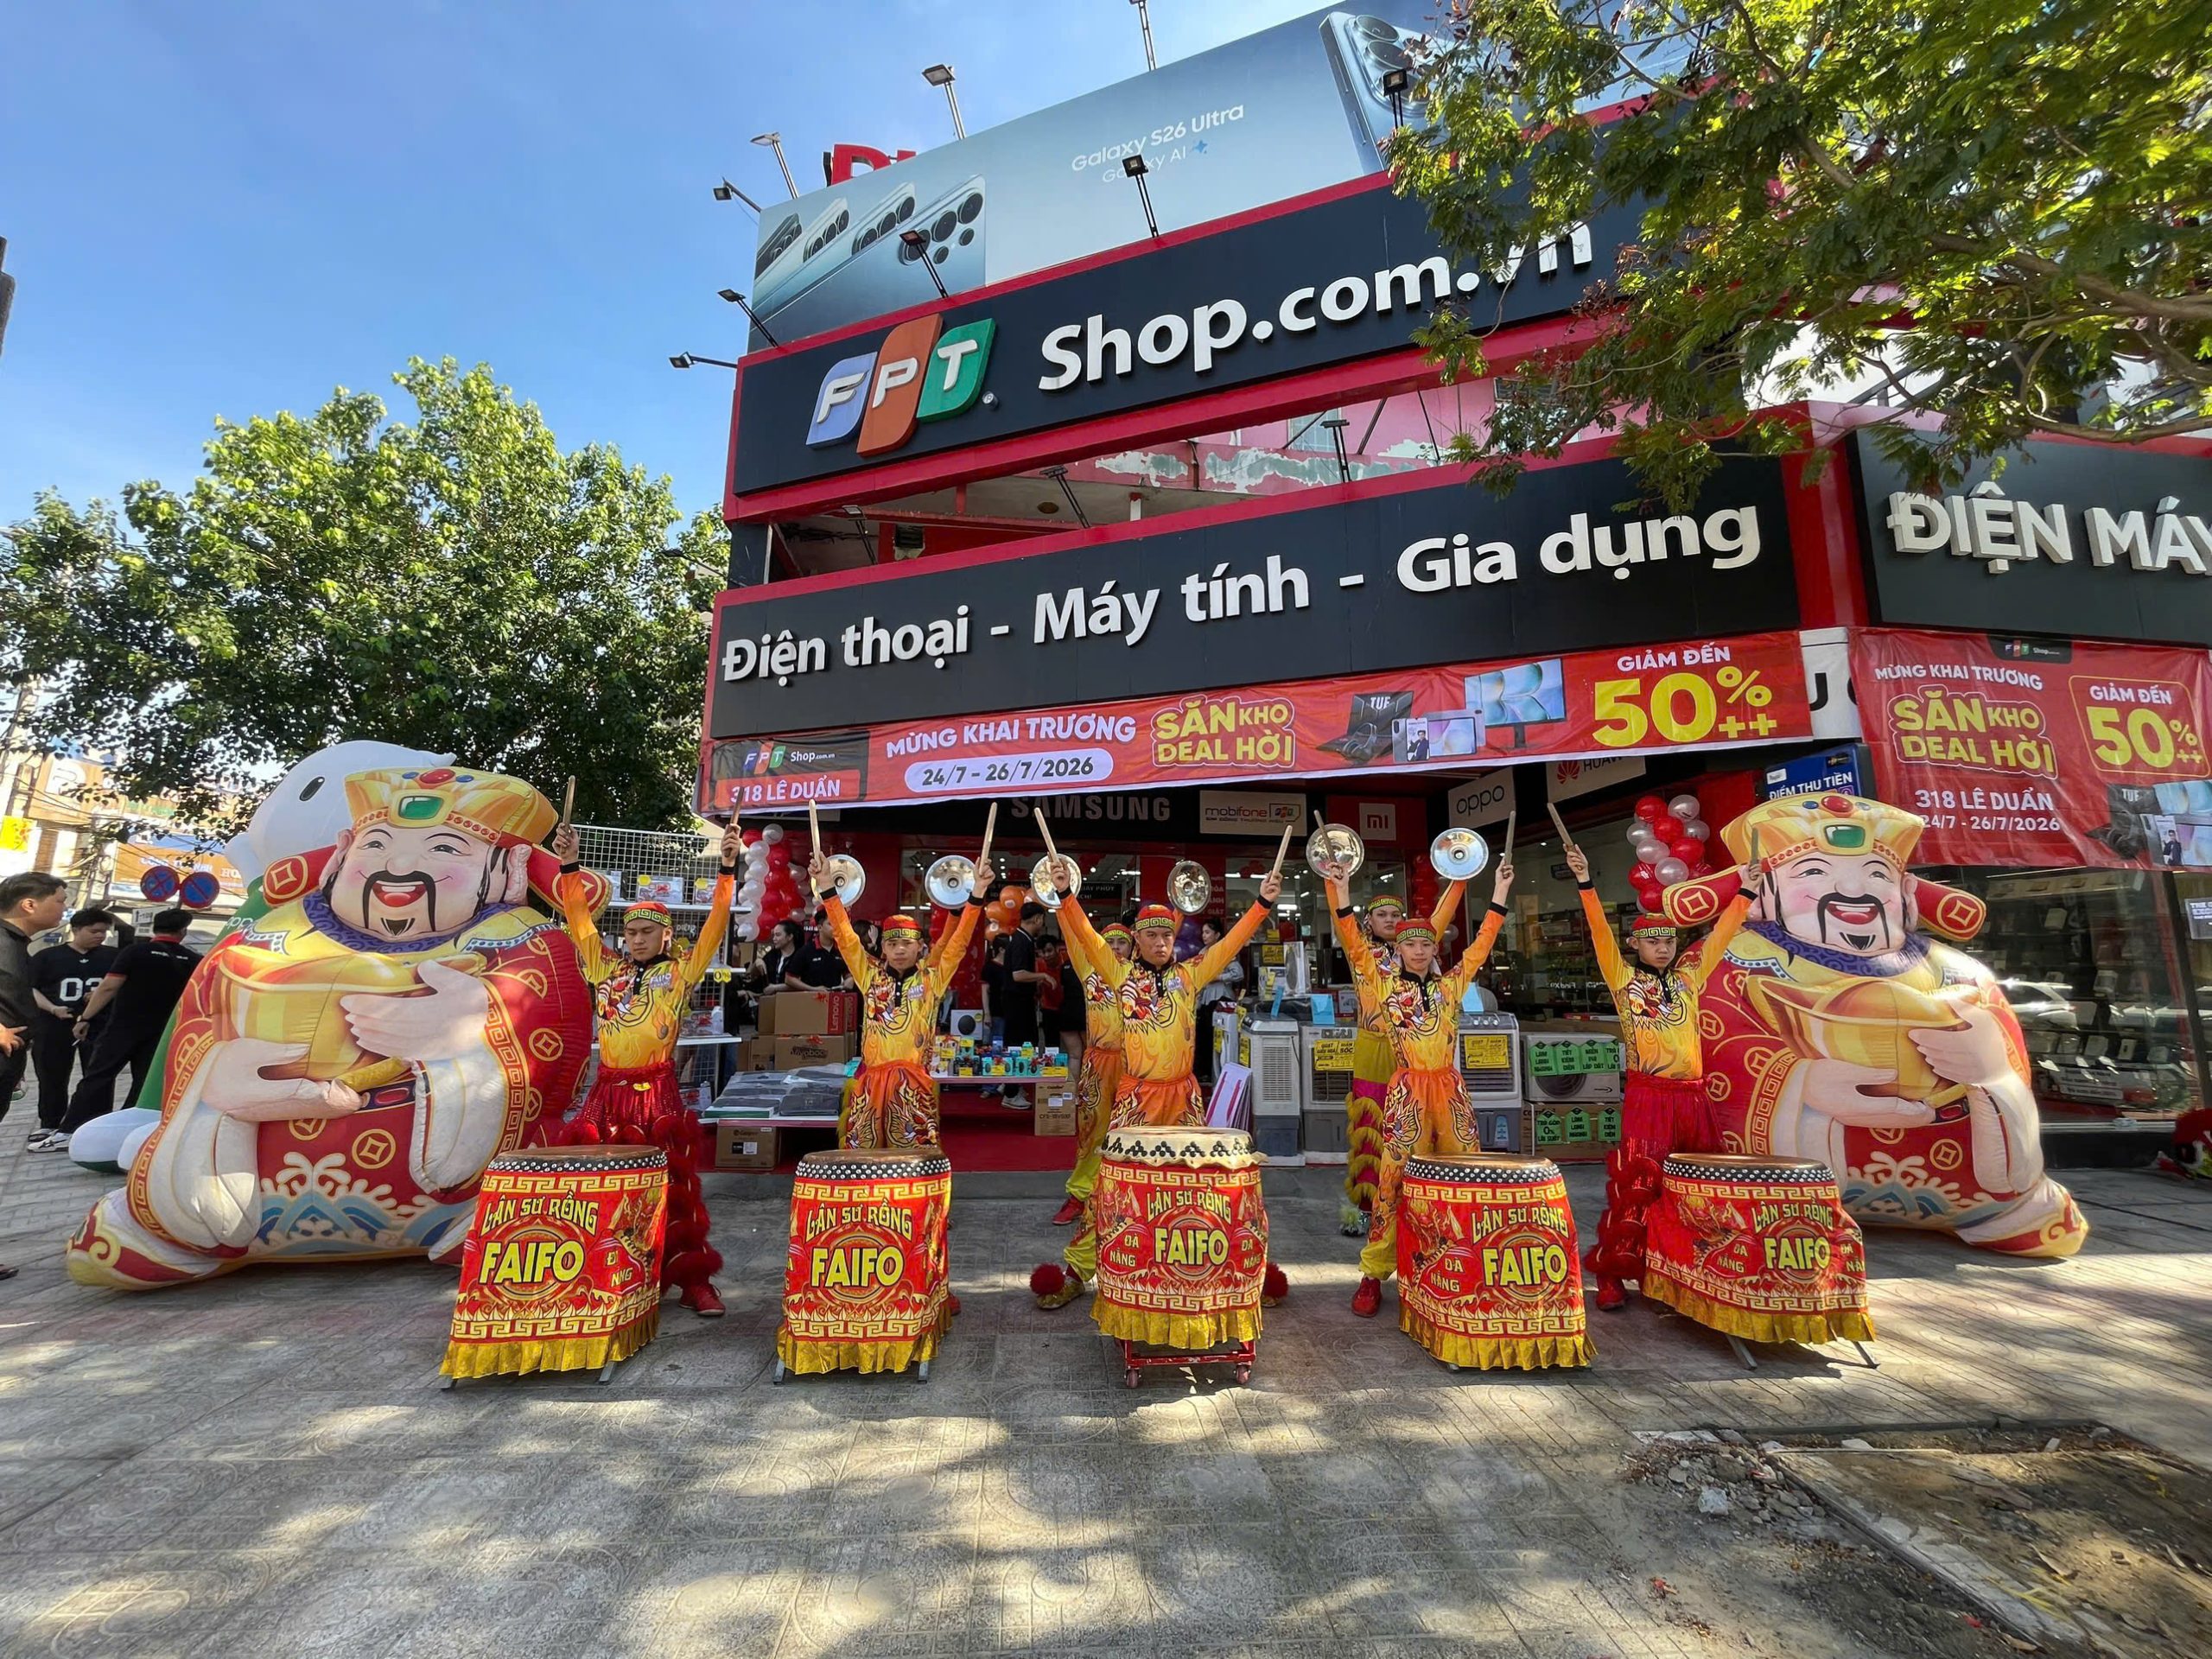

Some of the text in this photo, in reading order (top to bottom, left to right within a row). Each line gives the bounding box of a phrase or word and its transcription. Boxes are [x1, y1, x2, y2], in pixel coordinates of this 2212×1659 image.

[1071, 104, 1244, 172] Galaxy S26 Ultra
[1103, 145, 1186, 183] Gaxy AI
[814, 220, 1593, 427] FPT Shop.com.vn
[1886, 480, 2073, 575] ĐIỆN
[721, 628, 826, 688] Điện
[841, 603, 969, 671] thoại
[1033, 580, 1161, 647] Máy
[1180, 554, 1311, 623] tính
[1395, 531, 1518, 594] Gia
[1539, 504, 1762, 582] dụng
[1616, 640, 1732, 675] GIẢM ĐẾN
[1874, 662, 2044, 692] MỪNG KHAI TRƯƠNG
[2089, 682, 2173, 705] GIẢM ĐẾN
[1156, 699, 1288, 740] SĂN KHO
[1893, 690, 1987, 734] SĂN
[1987, 705, 2040, 730] KHO
[886, 713, 1136, 758] MỪNG KHAI TRƯƠNG
[1157, 728, 1293, 763] DEAL HỜI
[1901, 734, 2056, 774] DEAL HỜI
[766, 779, 787, 801] LÊ
[921, 765, 968, 787] 24/7
[984, 757, 1095, 782] 26/7/2026
[1798, 779, 1822, 793] THU
[1823, 771, 1853, 787] TIỀN
[1010, 794, 1171, 822] SAMSUNG
[1205, 806, 1268, 817] mobifone
[1915, 788, 1956, 810] 318
[1960, 787, 1990, 810] LÊ
[1922, 814, 1956, 830] 24/7
[1969, 813, 2062, 833] 26/7/2026
[830, 995, 840, 1032] Lenovo
[480, 1194, 516, 1236] LÂN
[805, 1204, 836, 1243] LÂN
[1147, 1186, 1172, 1224] LÂN
[1751, 1200, 1780, 1234] LÂN
[1471, 1204, 1503, 1245] LÂN
[479, 1240, 585, 1284] FAIFO
[810, 1245, 905, 1287] FAIFO
[1154, 1227, 1230, 1267] FAIFO
[1481, 1243, 1569, 1287] FAIFO
[1763, 1236, 1831, 1271] FAIFO
